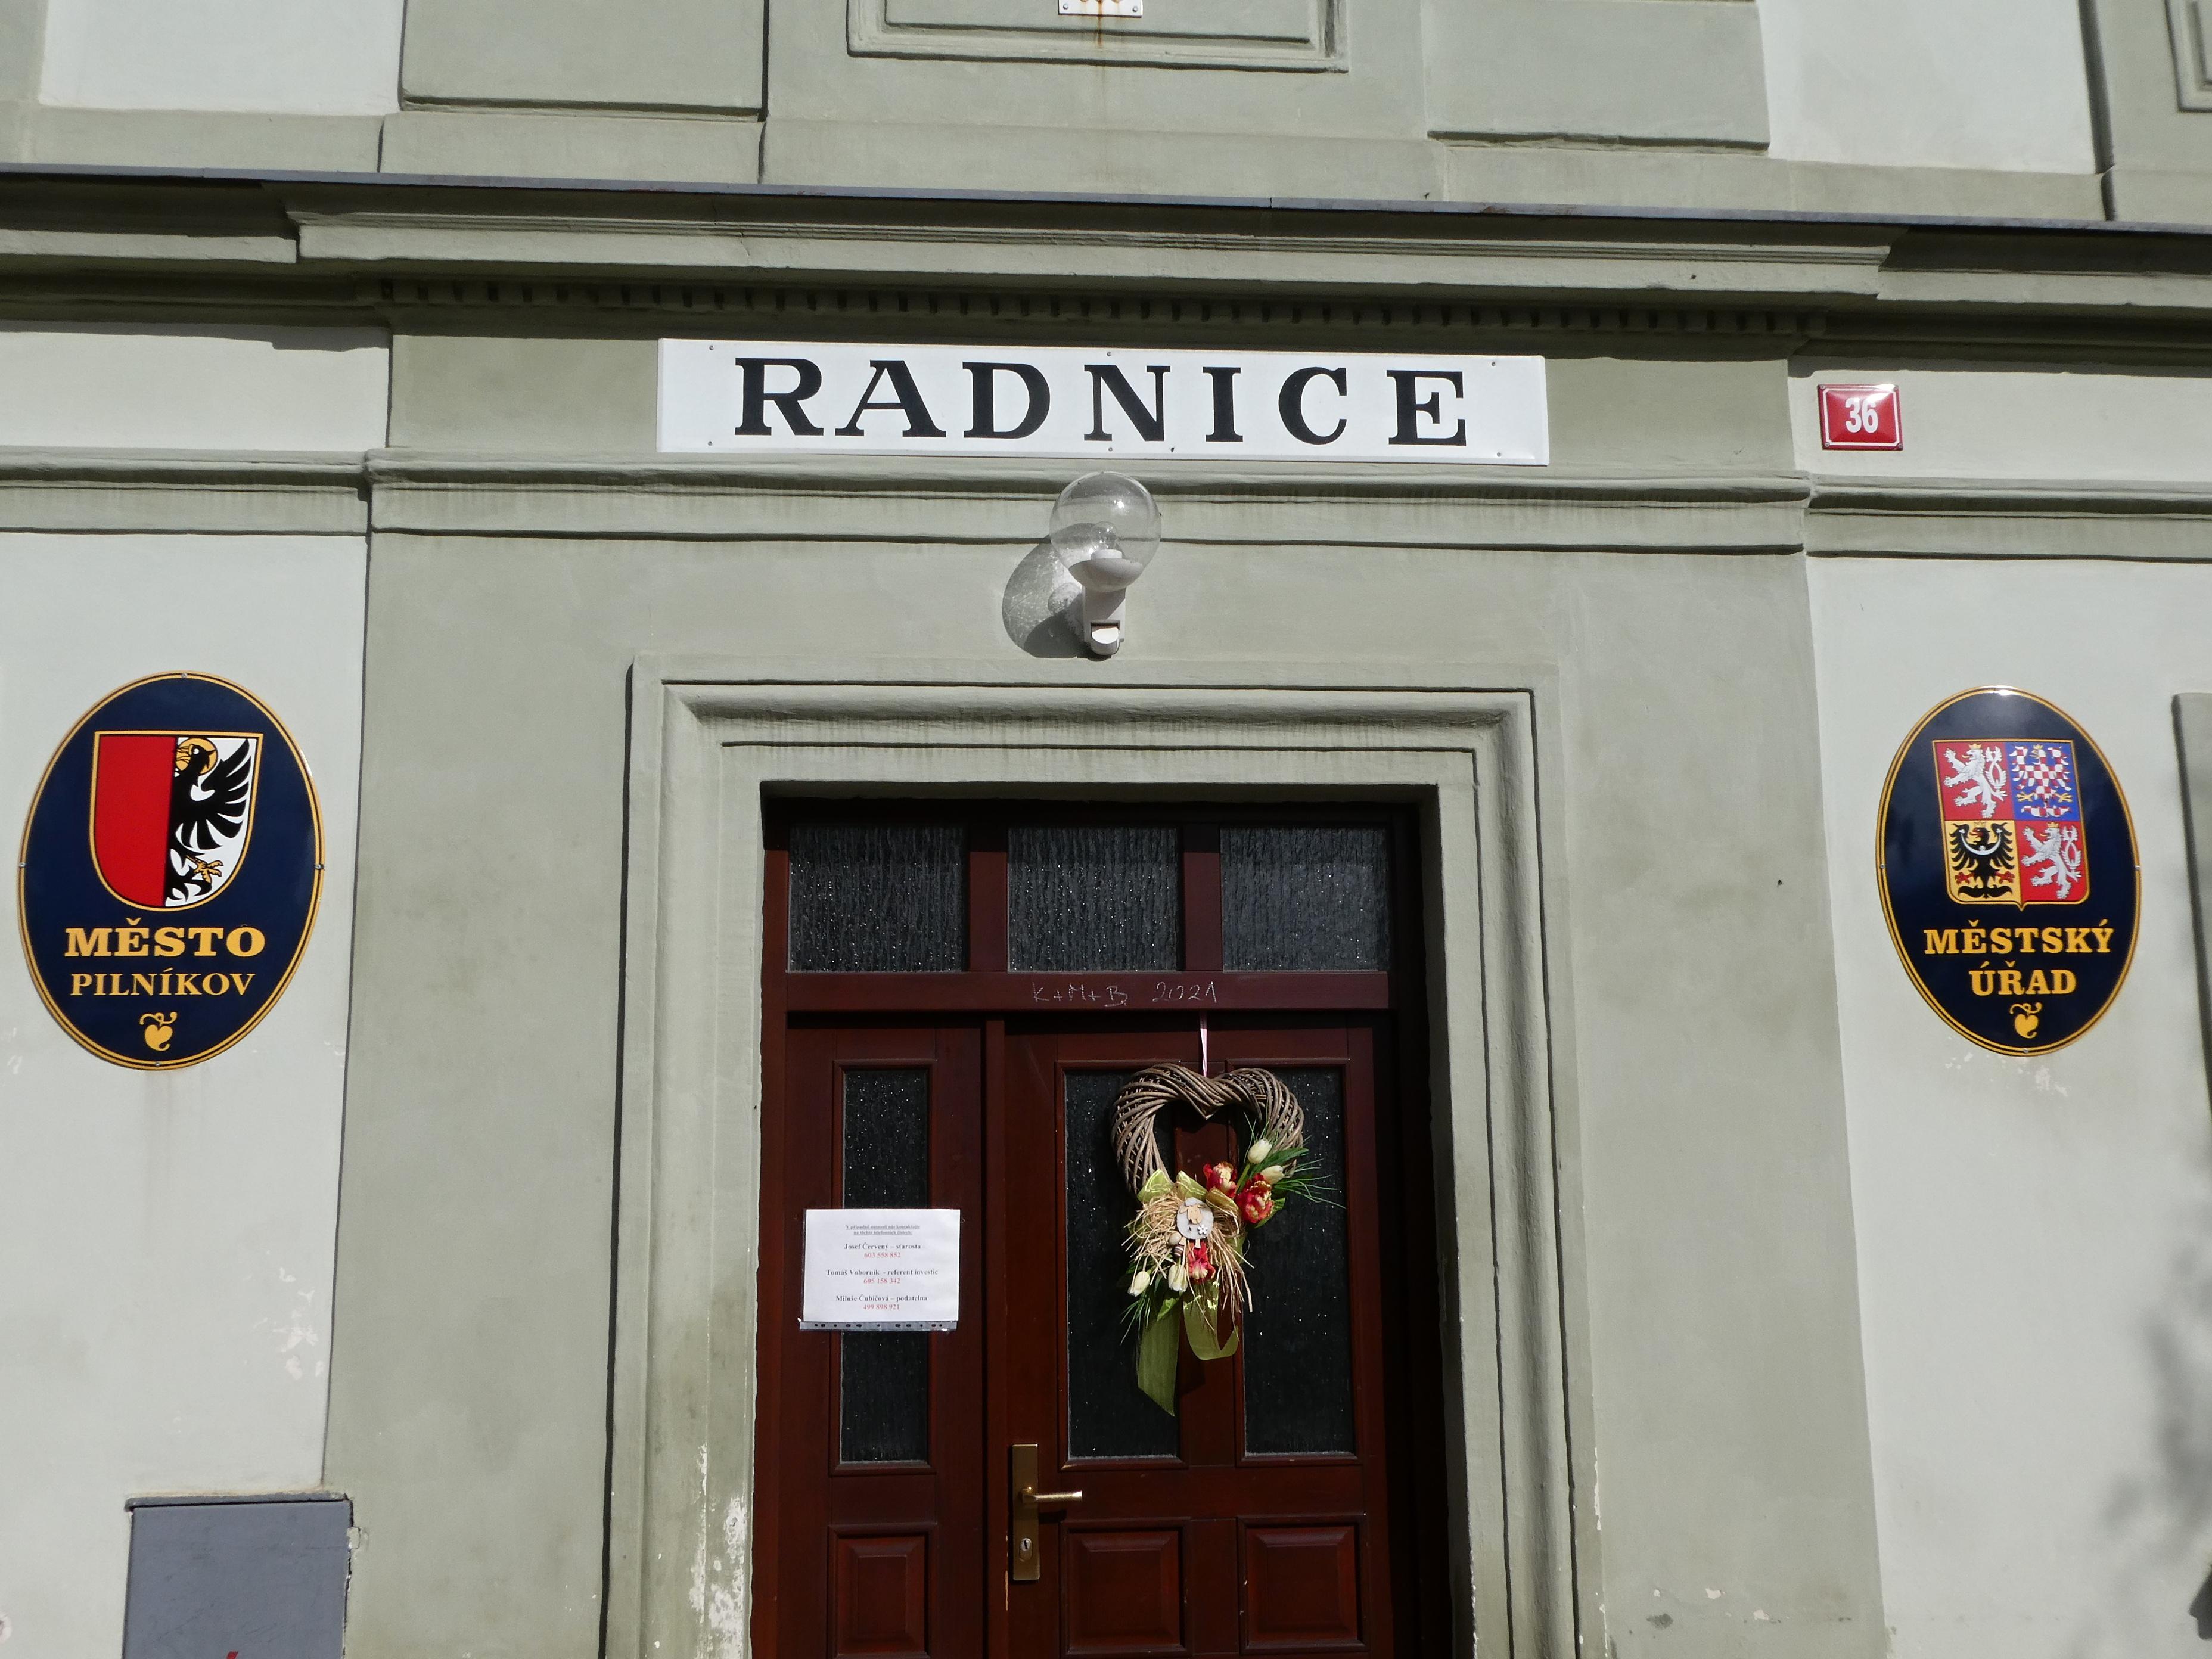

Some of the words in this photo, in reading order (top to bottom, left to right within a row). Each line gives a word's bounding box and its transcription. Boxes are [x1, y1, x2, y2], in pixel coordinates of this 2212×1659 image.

[735, 356, 1468, 446] RADNICE
[1845, 397, 1878, 433] 36
[64, 917, 266, 957] MĚSTO
[1923, 919, 2114, 955] MĚSTSKÝ
[70, 967, 256, 996] PILNÍKOV
[1152, 981, 1217, 1003] 2021
[1968, 960, 2077, 996] ÚŘAD
[862, 1242, 888, 1251] Červený
